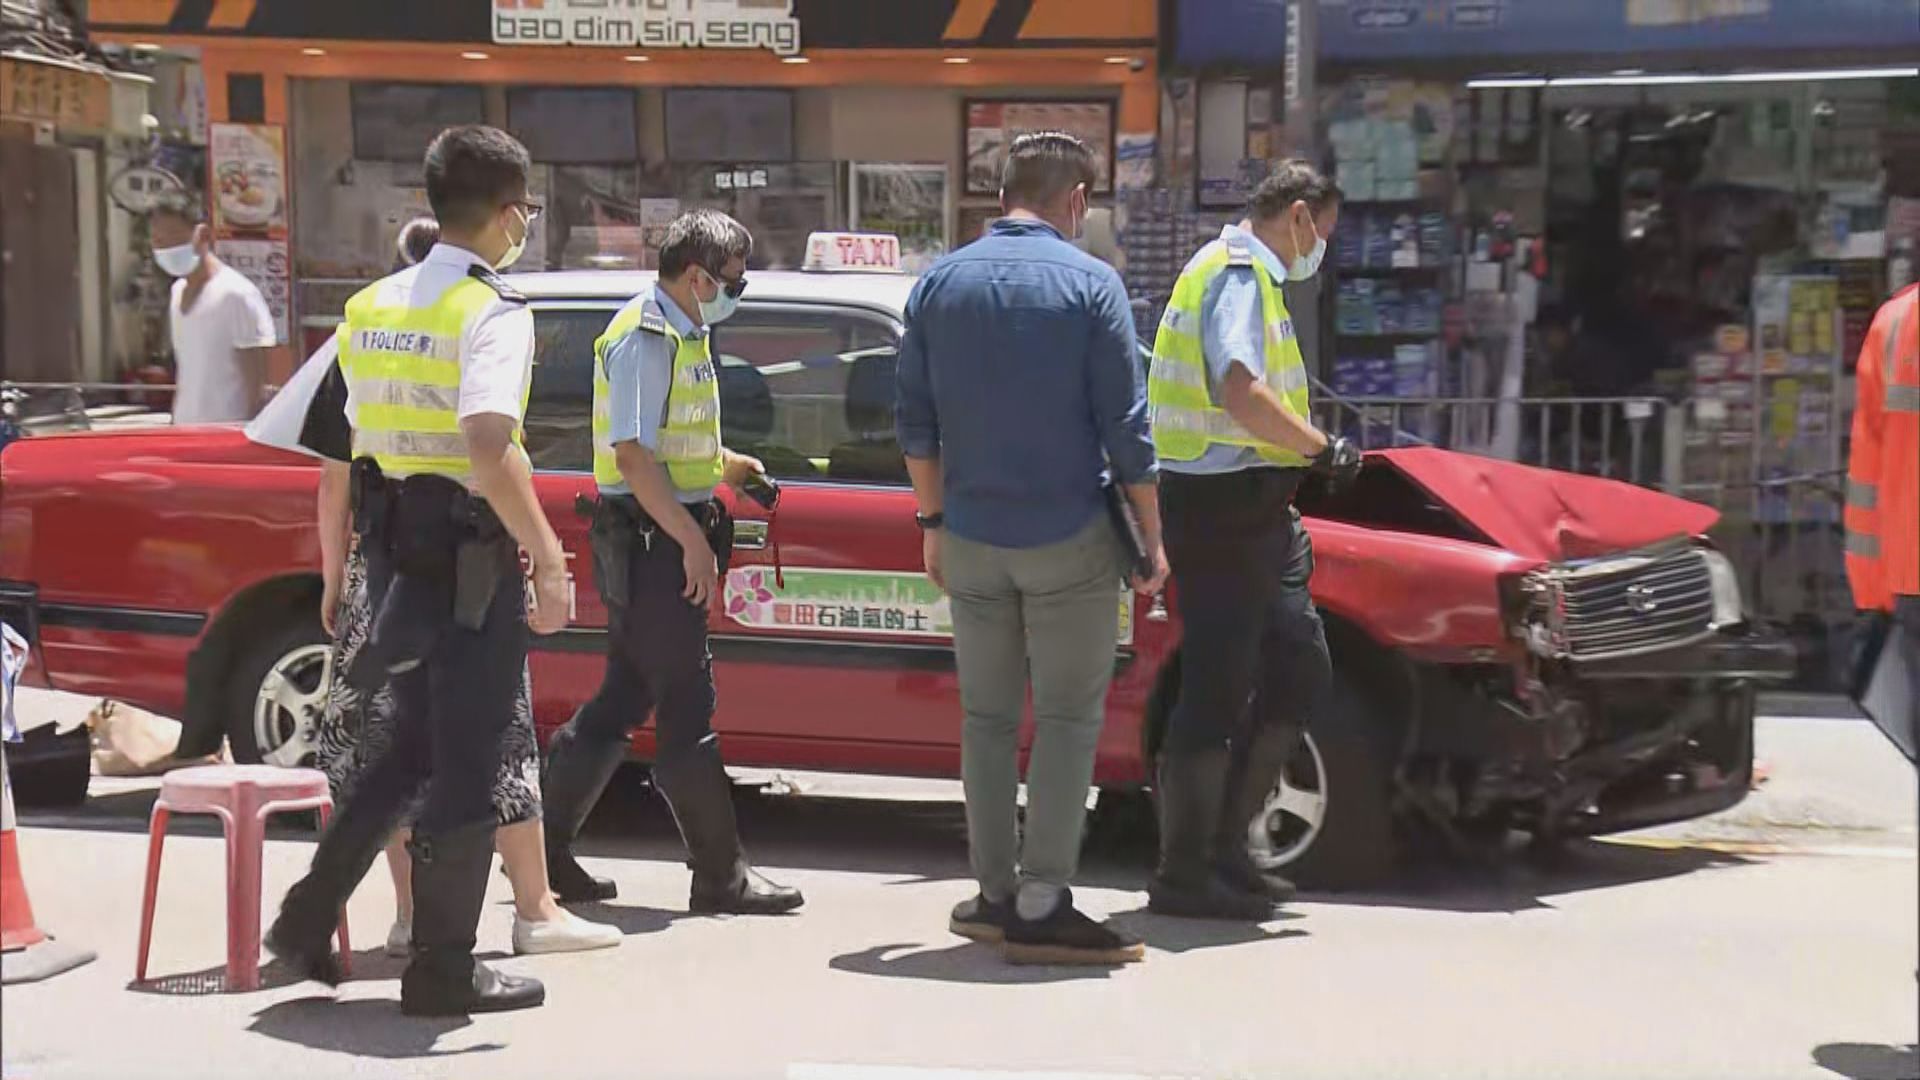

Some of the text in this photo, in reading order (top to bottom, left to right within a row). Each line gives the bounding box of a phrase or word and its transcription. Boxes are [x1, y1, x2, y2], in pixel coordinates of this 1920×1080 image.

[496, 14, 796, 51] bao dim sin seng
[837, 236, 894, 266] TAXI
[370, 331, 415, 351] POLICE
